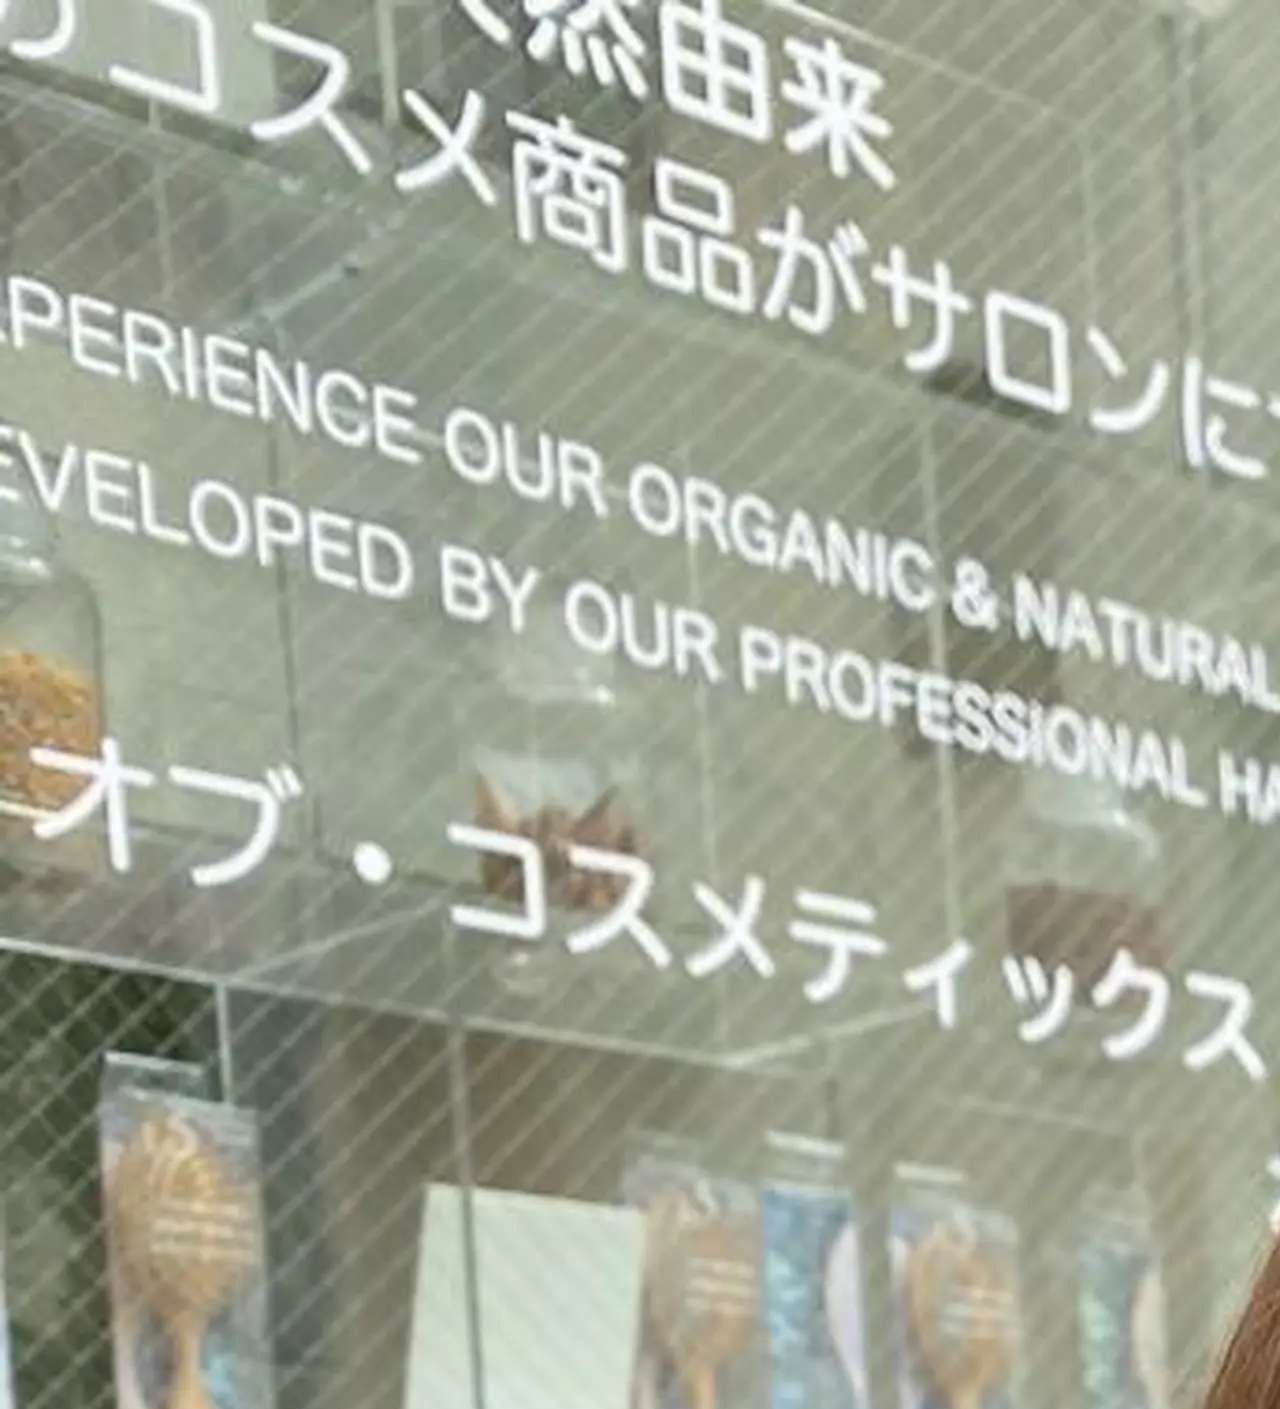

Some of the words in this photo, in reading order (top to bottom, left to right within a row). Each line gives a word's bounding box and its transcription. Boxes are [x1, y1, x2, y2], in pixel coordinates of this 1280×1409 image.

[460, 0, 895, 190] 然由来
[0, 276, 421, 464] PERIENCE
[444, 409, 607, 518] OUR
[629, 464, 935, 613] ORGANIC
[951, 558, 998, 632] &
[439, 546, 541, 632] BY
[564, 580, 720, 681] OUR
[740, 628, 1206, 807] PROFESSIONAL
